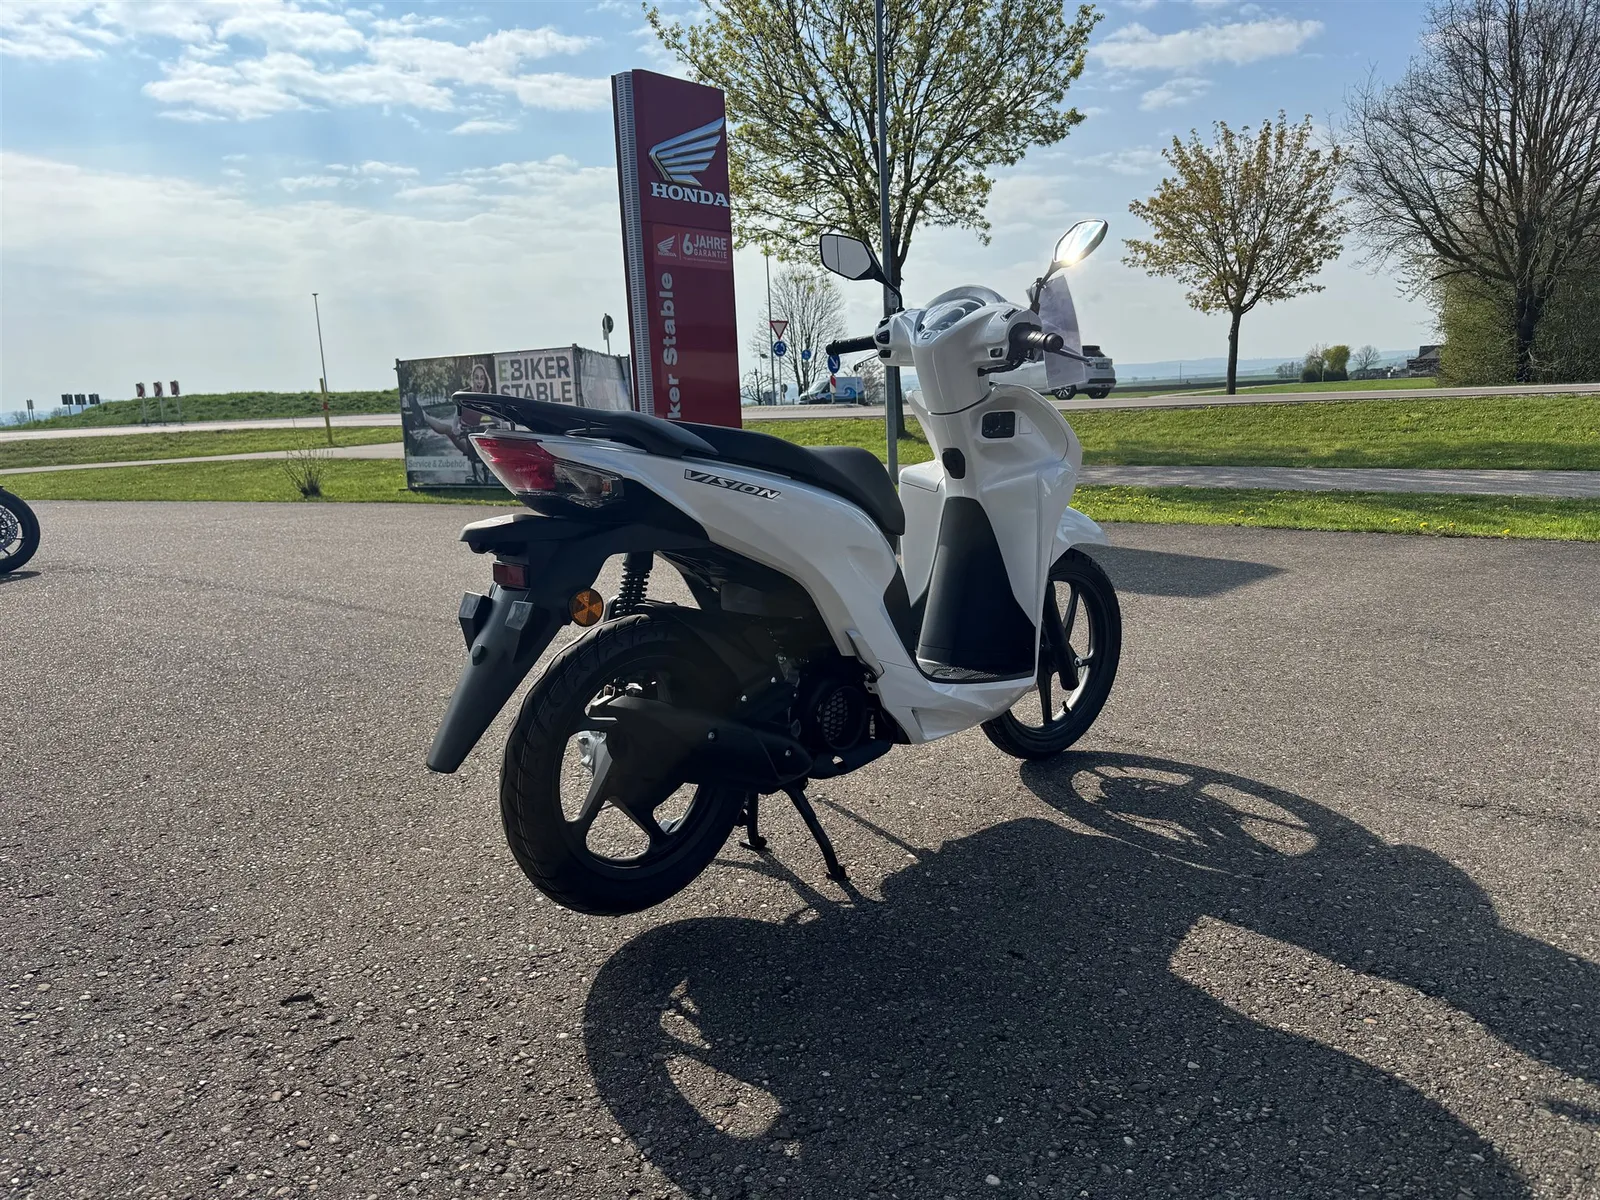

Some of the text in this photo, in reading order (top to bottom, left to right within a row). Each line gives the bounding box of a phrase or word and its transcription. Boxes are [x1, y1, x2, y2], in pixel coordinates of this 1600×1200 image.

[650, 182, 730, 208] HONDA
[682, 233, 728, 255] 6 JAHRE
[693, 248, 728, 259] GARANTIE
[659, 272, 682, 419] ker Stable
[408, 459, 466, 469] Service & Zubehör
[684, 469, 781, 500] VISION
